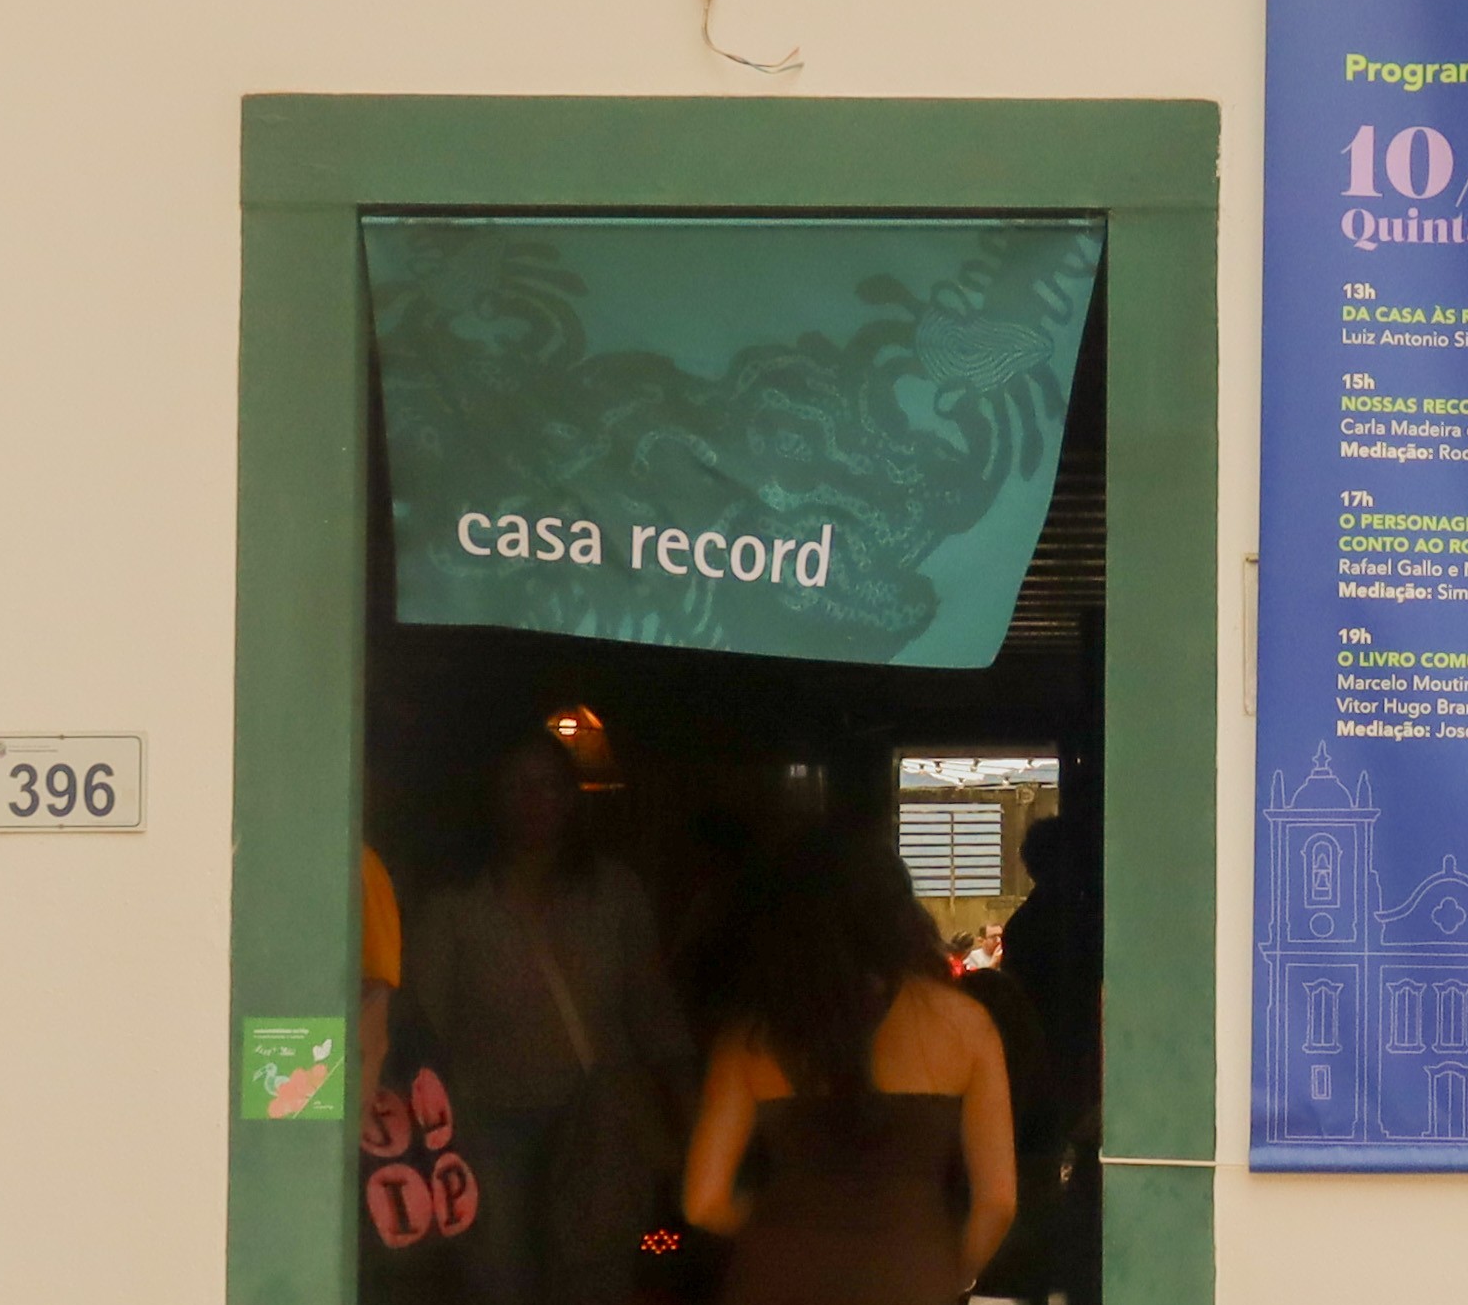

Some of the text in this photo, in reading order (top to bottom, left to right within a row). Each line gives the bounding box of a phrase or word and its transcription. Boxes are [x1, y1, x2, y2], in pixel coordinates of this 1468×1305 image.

[1343, 283, 1375, 299] 13h
[1343, 306, 1370, 321] DA
[1376, 307, 1426, 323] CASA
[1431, 305, 1456, 324] ÀS
[1343, 328, 1375, 344] Luiz
[1380, 330, 1449, 347] Antonio
[1342, 373, 1375, 389] 15h
[1342, 396, 1417, 413] NOSSAS
[1341, 441, 1433, 463] Mediação:
[1341, 491, 1373, 507] 17h
[1339, 513, 1355, 529] O
[458, 512, 832, 587] casa record
[1339, 536, 1408, 552] CONTO
[1415, 538, 1443, 553] AO
[1339, 582, 1432, 603] Mediação:
[1339, 628, 1371, 644] 19h
[1338, 651, 1353, 666] O
[1360, 652, 1415, 667] LIVRO
[1336, 697, 1378, 713] Vitor
[1384, 698, 1431, 718] Hugo
[1337, 720, 1430, 741] Mediação:
[9, 763, 116, 818] 396
